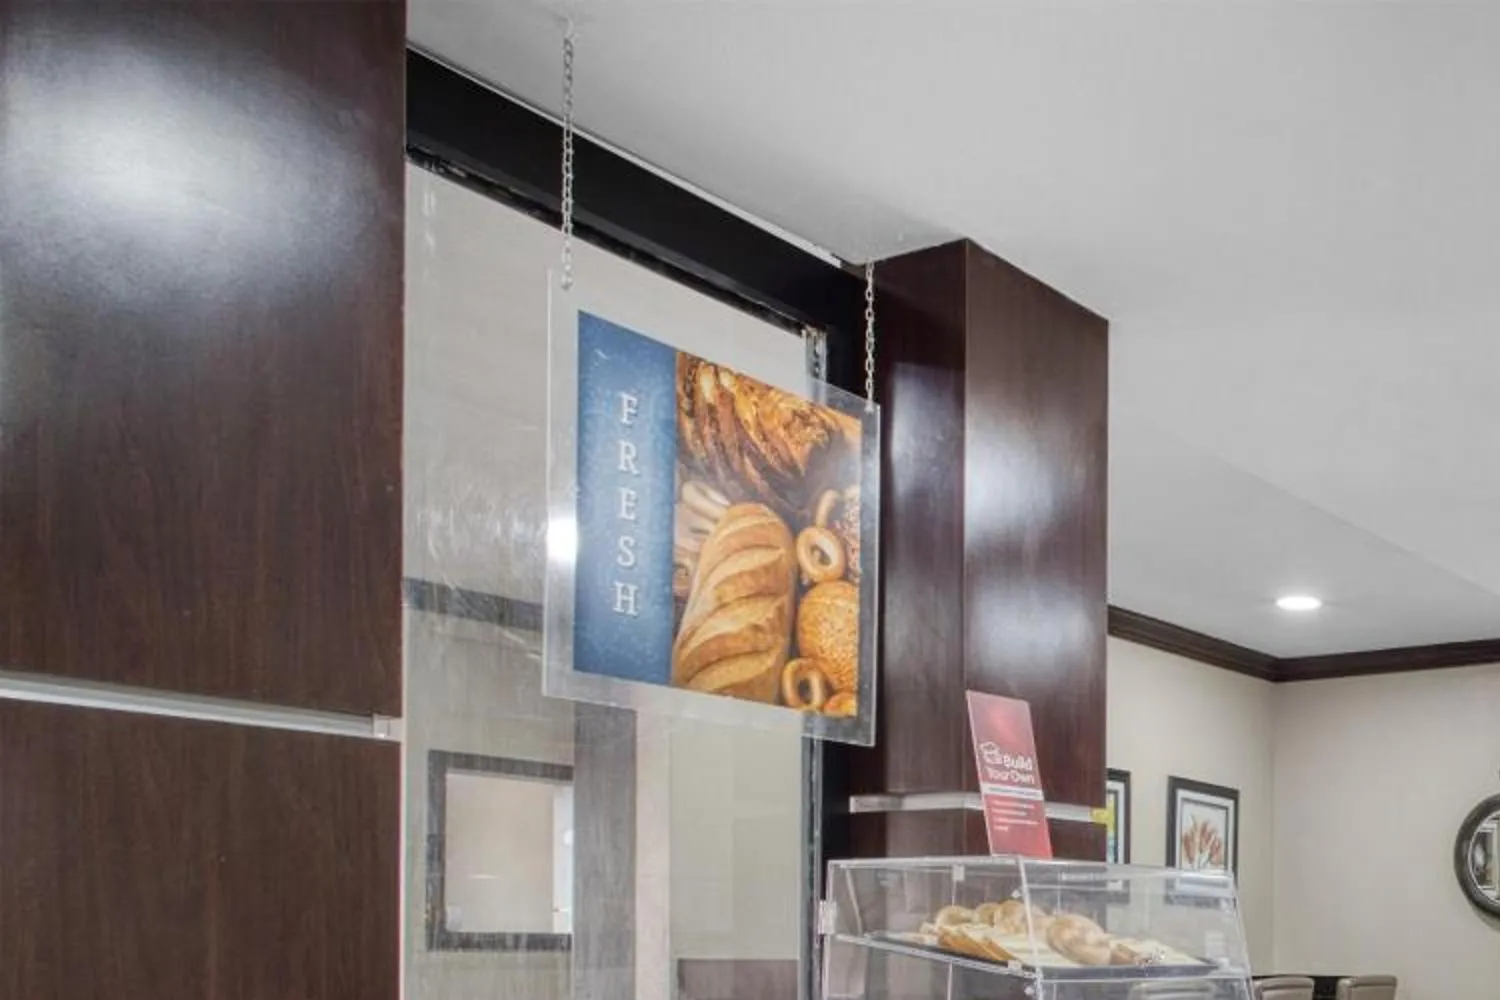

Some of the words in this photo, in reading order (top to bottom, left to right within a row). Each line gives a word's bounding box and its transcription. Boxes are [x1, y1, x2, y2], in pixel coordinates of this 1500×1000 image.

[612, 391, 641, 617] FRESH
[1003, 754, 1033, 771] Build
[985, 766, 1010, 781] Your
[1010, 769, 1035, 785] Own
